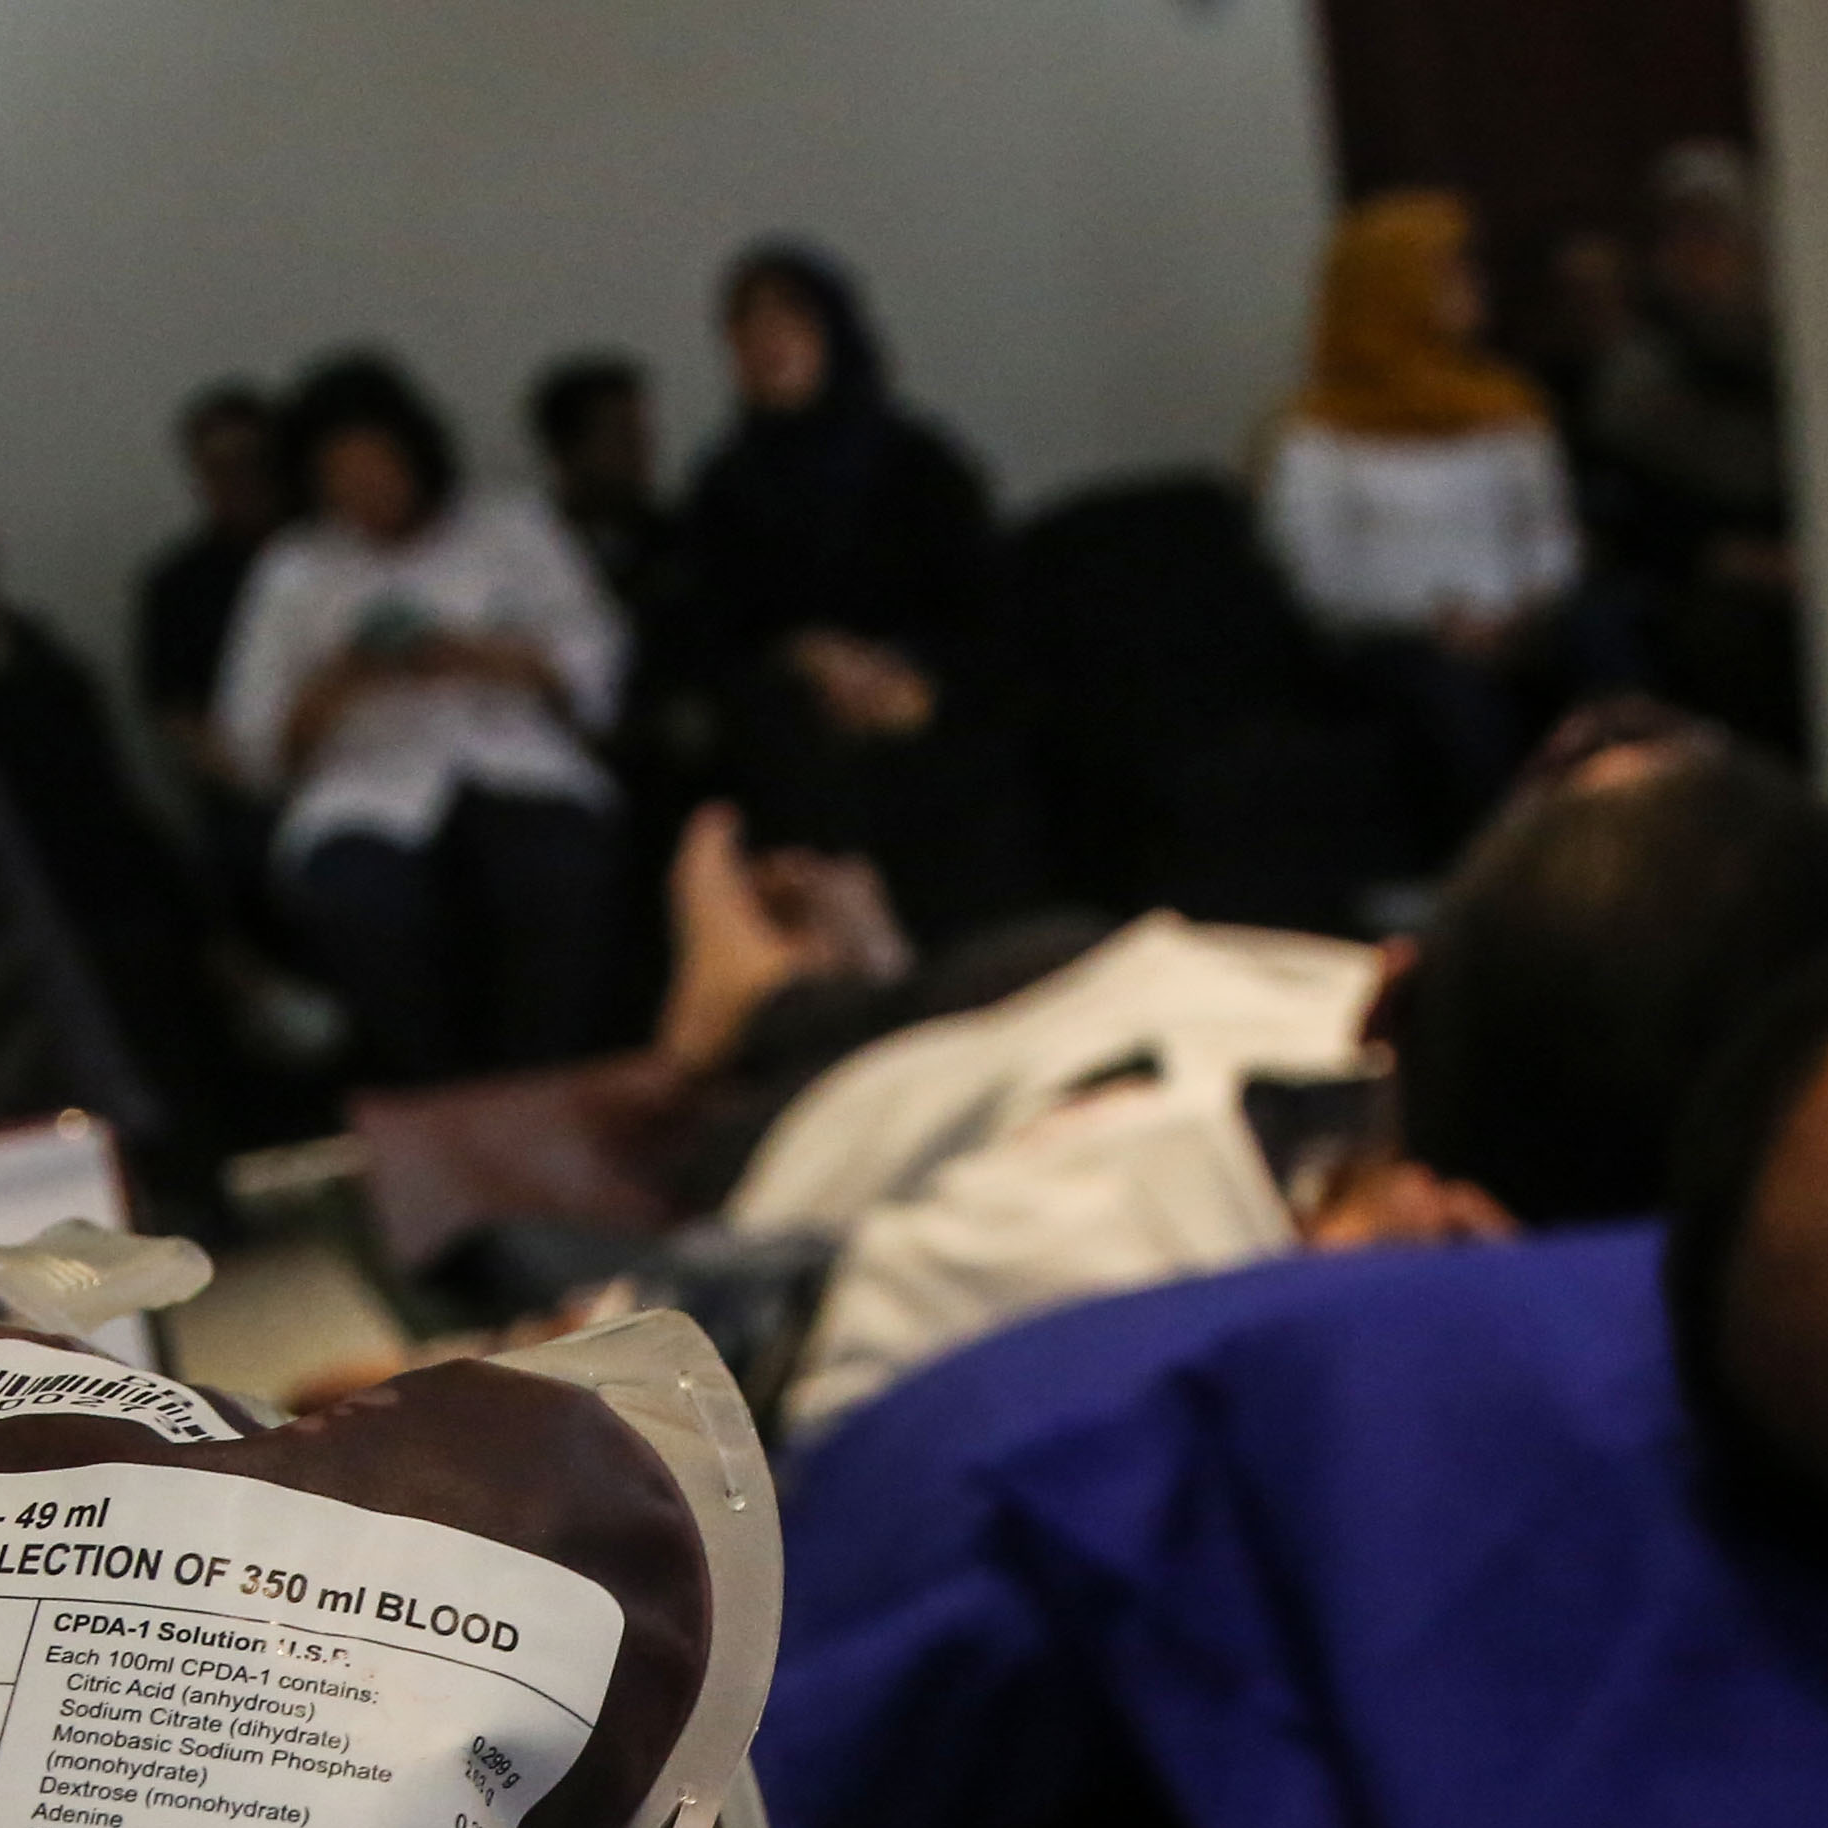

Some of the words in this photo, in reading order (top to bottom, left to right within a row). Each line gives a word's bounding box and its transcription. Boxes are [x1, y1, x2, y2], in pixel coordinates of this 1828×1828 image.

[15, 1501, 58, 1531] 49
[64, 1497, 112, 1530] ml
[174, 1552, 232, 1588] OF
[239, 1564, 309, 1605] 350
[317, 1586, 366, 1616] ml
[375, 1591, 521, 1653] BLOOD
[54, 1611, 151, 1639] CPDA-1
[157, 1621, 267, 1655] Solution
[45, 1645, 100, 1667] Each
[109, 1649, 175, 1675] 100ml
[181, 1657, 270, 1687] CPDA-1
[278, 1673, 379, 1705] contains:
[67, 1672, 121, 1695] Citric
[126, 1678, 176, 1701] Acid
[182, 1684, 315, 1723] (anhydrous)
[60, 1697, 142, 1724] Sodium
[150, 1706, 223, 1733] Citrate
[229, 1716, 351, 1753] (dihydrate)
[46, 1750, 209, 1789] (monohydrate)
[52, 1723, 173, 1754] Monobasic
[178, 1737, 264, 1766] Sodium
[271, 1750, 393, 1784] Phosphate
[473, 1735, 513, 1777] 0.299
[39, 1775, 138, 1804] Dextrose
[31, 1802, 124, 1828] Adenine
